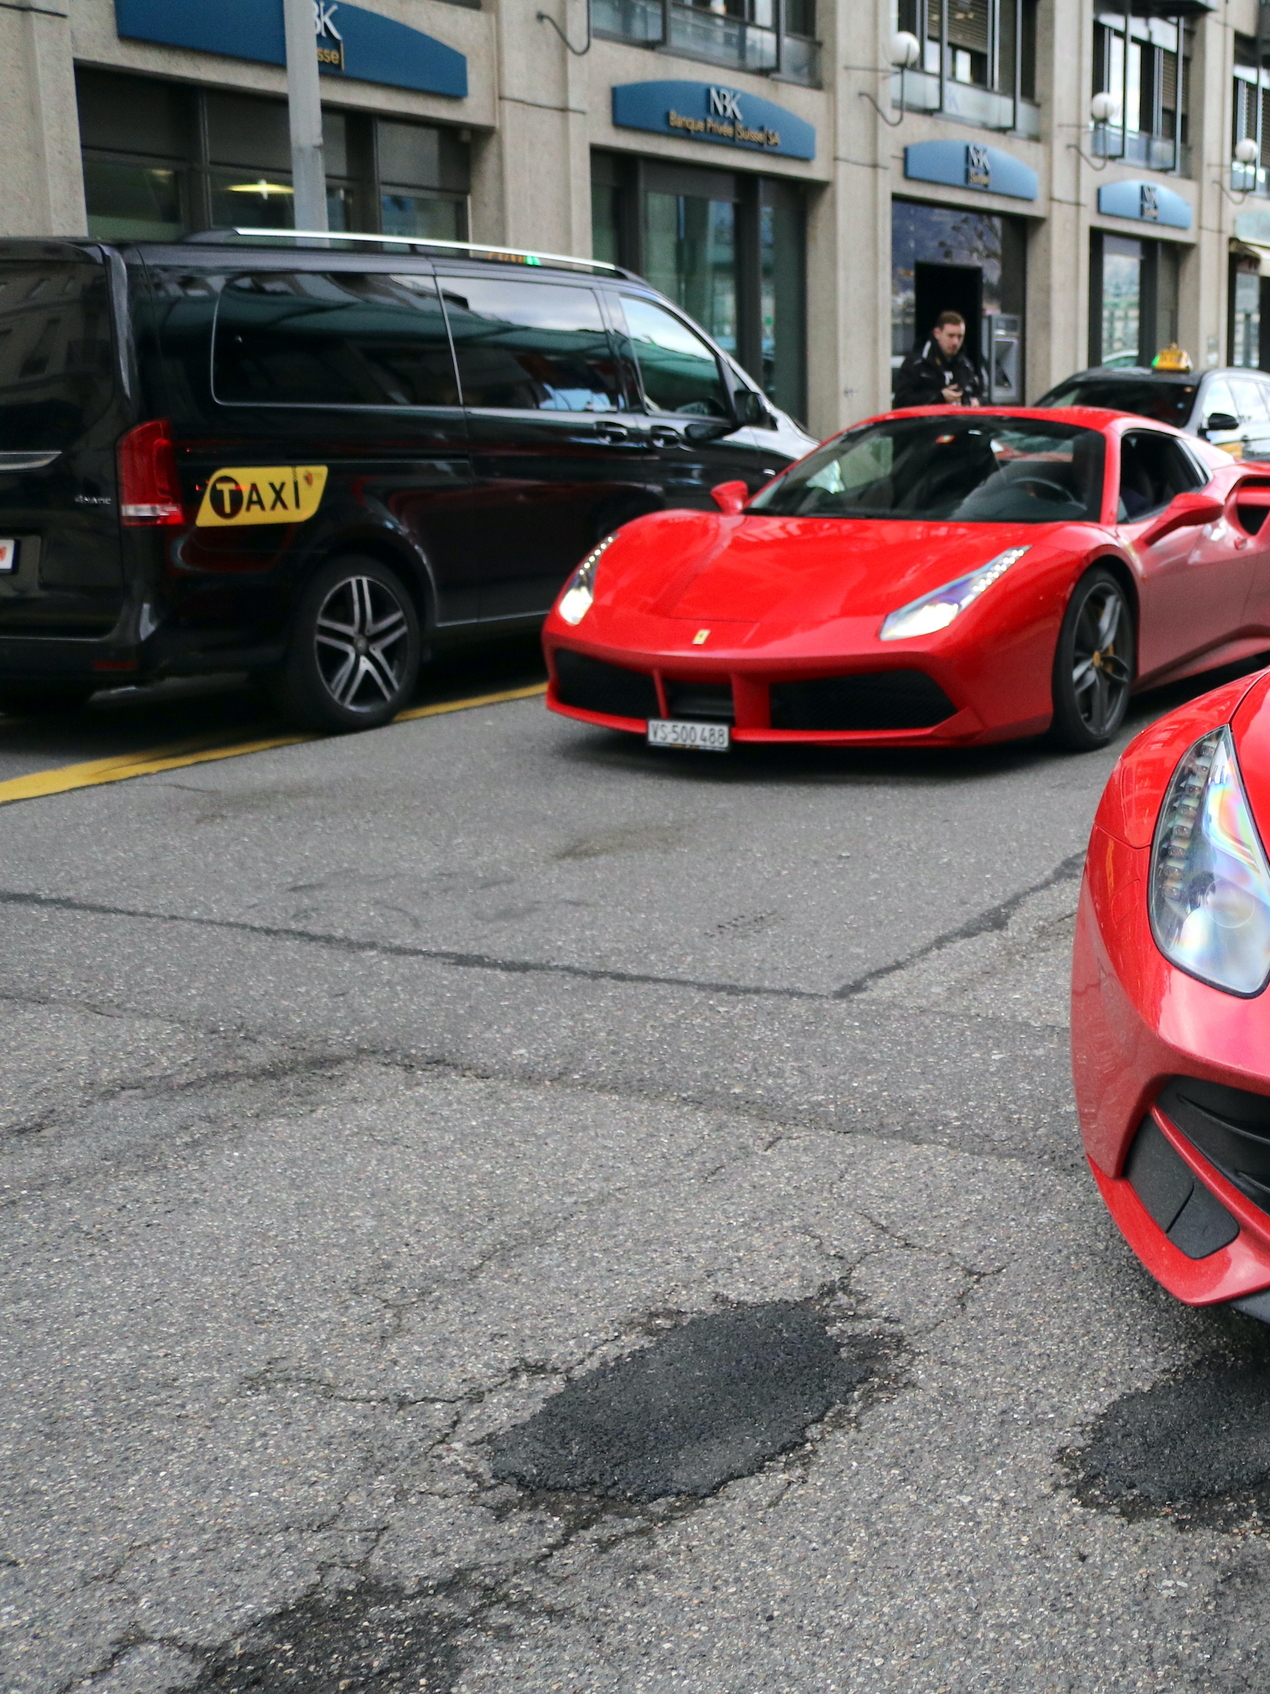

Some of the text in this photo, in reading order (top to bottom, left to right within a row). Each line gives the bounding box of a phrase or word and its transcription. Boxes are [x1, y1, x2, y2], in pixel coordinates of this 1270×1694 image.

[709, 86, 743, 120] NBK
[668, 109, 706, 135] Banque
[210, 476, 300, 518] TAXI
[700, 727, 725, 745] 488
